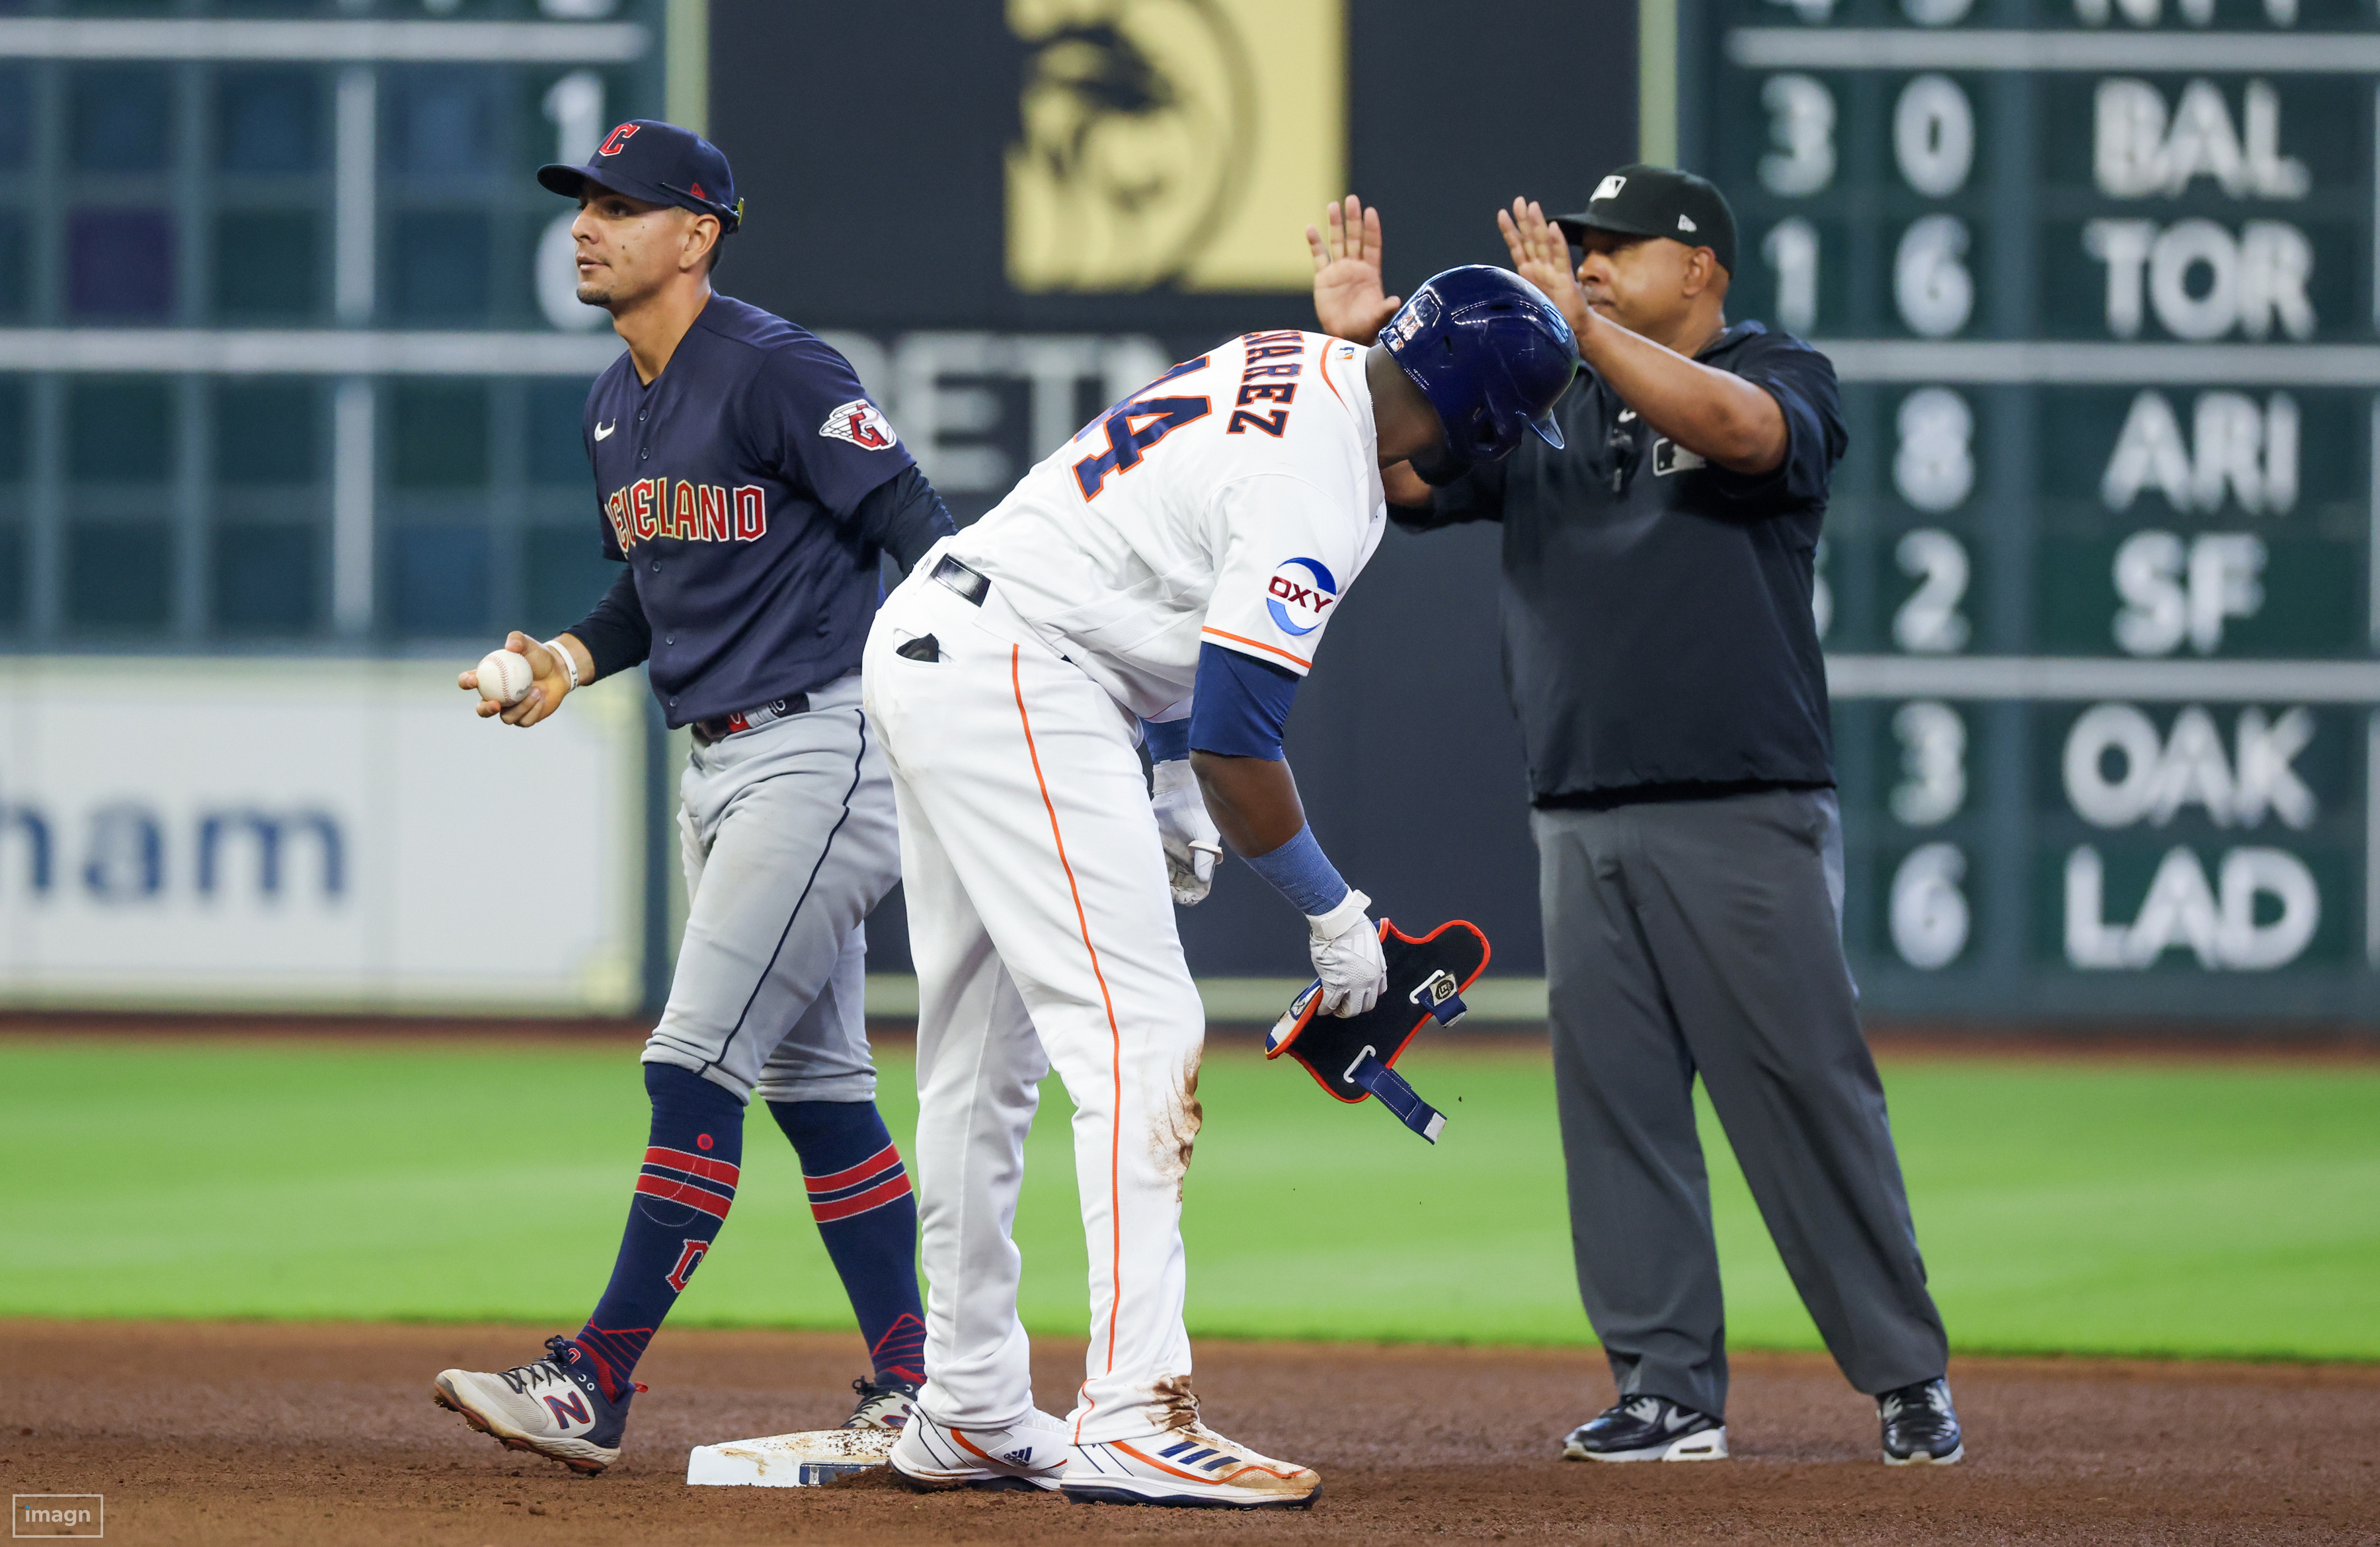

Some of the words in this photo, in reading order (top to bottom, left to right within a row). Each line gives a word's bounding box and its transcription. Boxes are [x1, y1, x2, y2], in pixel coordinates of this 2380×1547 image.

[599, 123, 641, 157] C
[1757, 74, 1838, 197] 3
[1893, 74, 1974, 198] 0
[2094, 77, 2311, 200] BAL
[1762, 216, 1821, 337] 1
[1893, 214, 1974, 338] 6
[2082, 217, 2316, 340] TOR
[1226, 329, 1304, 438] VAREZ
[1893, 385, 1974, 511] 8
[2101, 389, 2301, 516] ARI
[604, 477, 767, 559] EELAND
[1269, 576, 1333, 613] OXY
[1892, 528, 1973, 654] 2
[2112, 530, 2268, 656] SF
[1889, 701, 1967, 826] 3
[2061, 703, 2318, 829] OAK
[1887, 844, 1970, 969] 6
[2062, 844, 2320, 971] LAD
